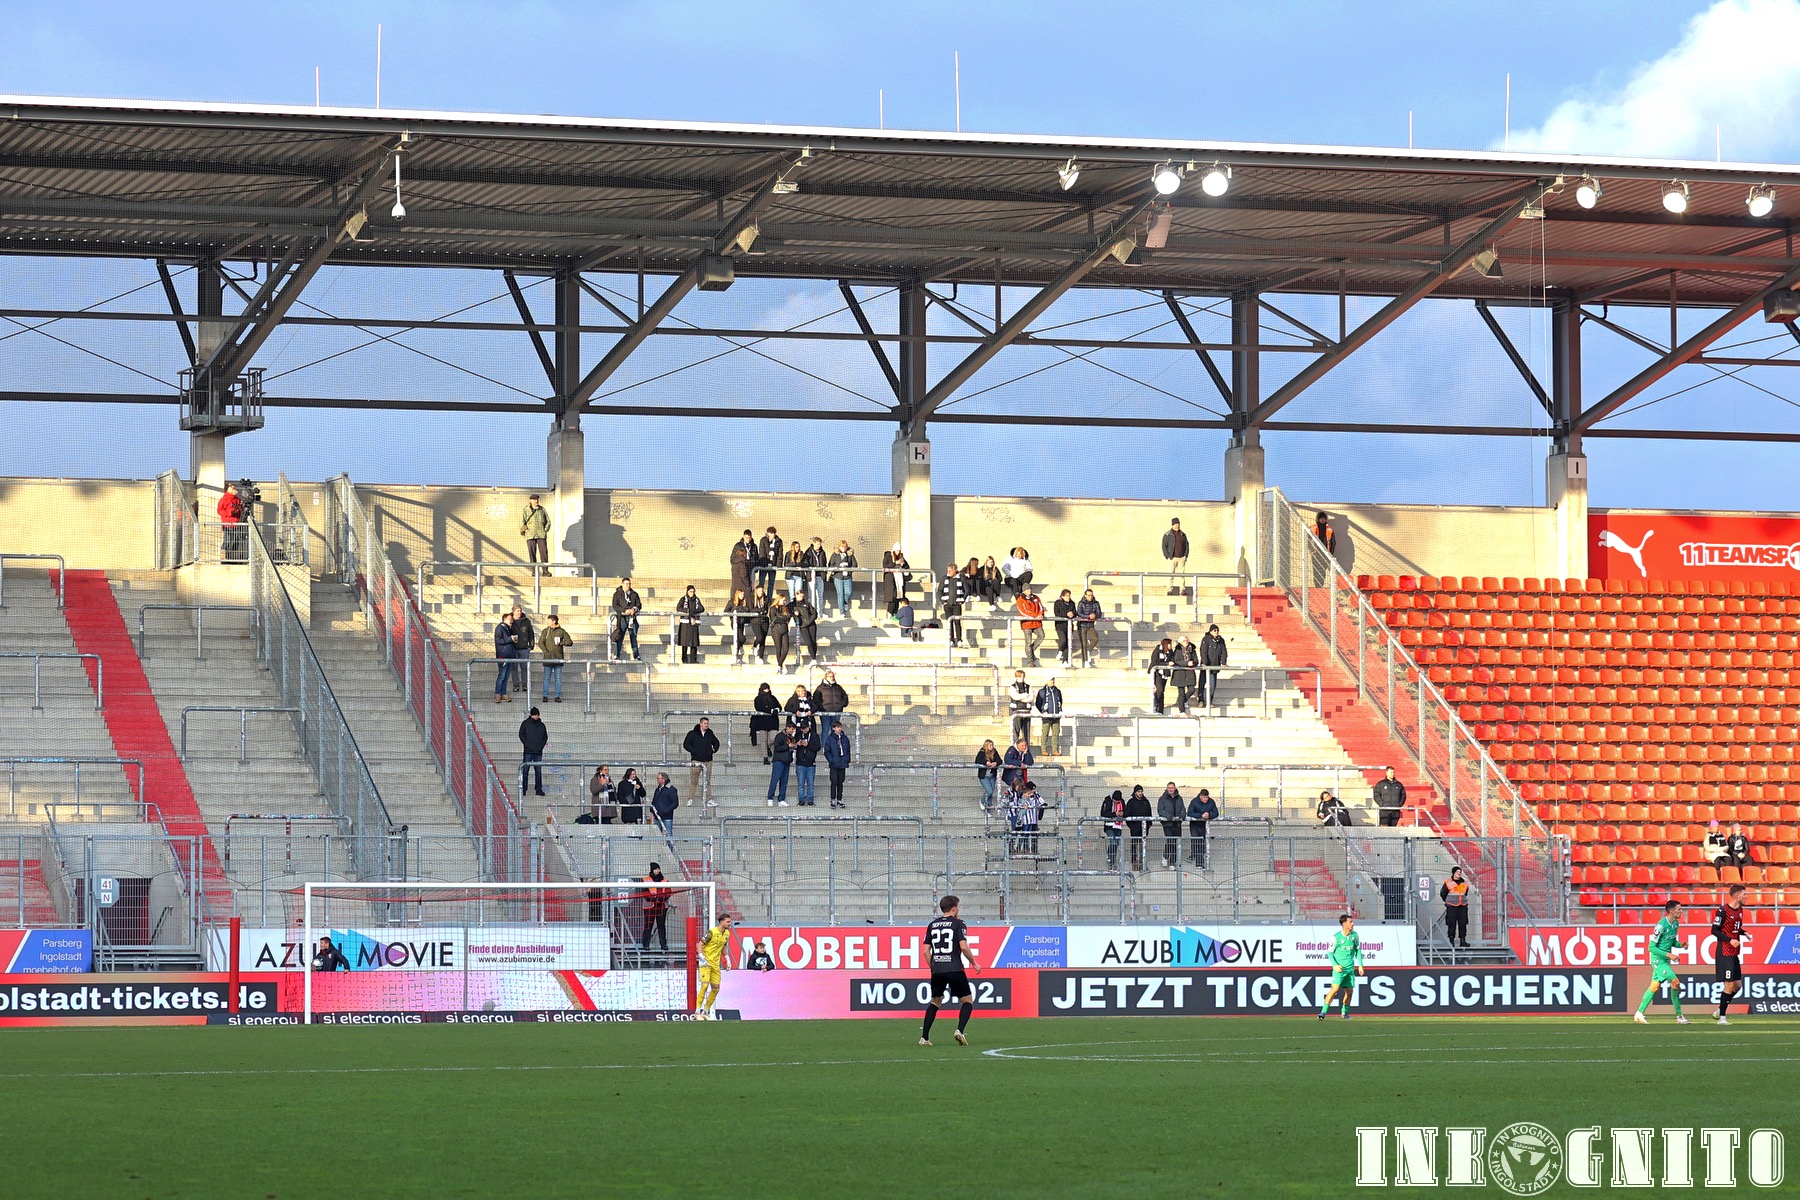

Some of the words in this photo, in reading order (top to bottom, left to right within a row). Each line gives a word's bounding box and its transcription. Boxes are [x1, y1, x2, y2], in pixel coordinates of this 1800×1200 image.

[102, 880, 112, 889] 41
[1419, 879, 1429, 888] 43
[103, 894, 110, 902] N
[42, 938, 83, 949] Parsberg
[930, 928, 954, 954] 23
[1024, 934, 1060, 946] Parsberg
[468, 945, 490, 954] Finde
[491, 945, 514, 954] deine
[515, 945, 564, 955] Ausbildung!
[739, 927, 980, 969] MÖBELHF
[1101, 939, 1181, 964] AZUBI
[1194, 939, 1282, 964] MOVIE
[1296, 942, 1319, 950] Finde
[40, 952, 83, 963] Ingolstadt
[255, 942, 343, 968] AZUI
[357, 941, 454, 967] MOVIE
[1021, 947, 1060, 958] Ingolstadt
[478, 955, 556, 963] www.azubimovie.de
[1725, 970, 1732, 979] 8
[860, 982, 906, 1004] MO
[1052, 976, 1193, 1009] JETZT
[1206, 975, 1397, 1009] TICKETS
[1410, 974, 1614, 1007] SICHERN!
[1755, 1001, 1767, 1012] si
[228, 1014, 241, 1025] si
[323, 1012, 336, 1024] si
[339, 1012, 422, 1024] electronics
[446, 1011, 459, 1023] si
[537, 1011, 550, 1022] si
[553, 1011, 633, 1022] electronics
[656, 1011, 668, 1021] si
